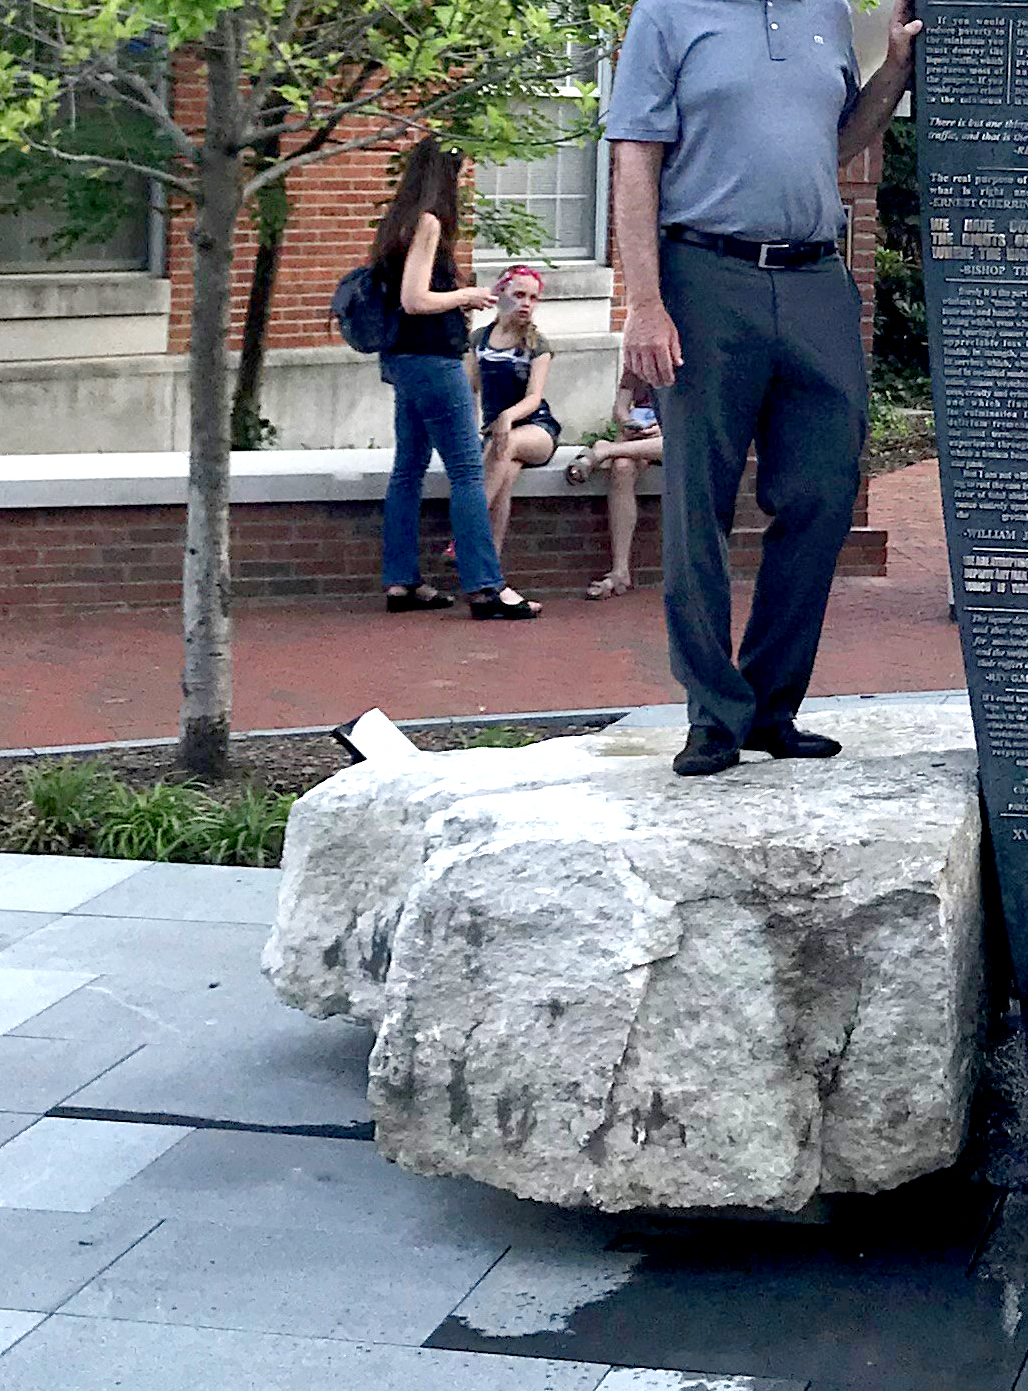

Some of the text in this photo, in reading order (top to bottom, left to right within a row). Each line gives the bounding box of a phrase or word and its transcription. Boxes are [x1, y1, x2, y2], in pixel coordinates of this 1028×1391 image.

[930, 117, 956, 128] There
[958, 117, 967, 128] is
[968, 118, 984, 128] but
[985, 120, 1002, 128] one
[961, 131, 980, 141] and
[982, 131, 1001, 142] that
[1002, 132, 1011, 142] is
[930, 173, 949, 183] The
[952, 174, 971, 183] real
[1017, 175, 1028, 185] of
[929, 186, 953, 196] what
[962, 187, 971, 196] is
[931, 232, 953, 245] THE
[960, 265, 1006, 276] -BISHOP
[963, 528, 1016, 540] -WILLIAM
